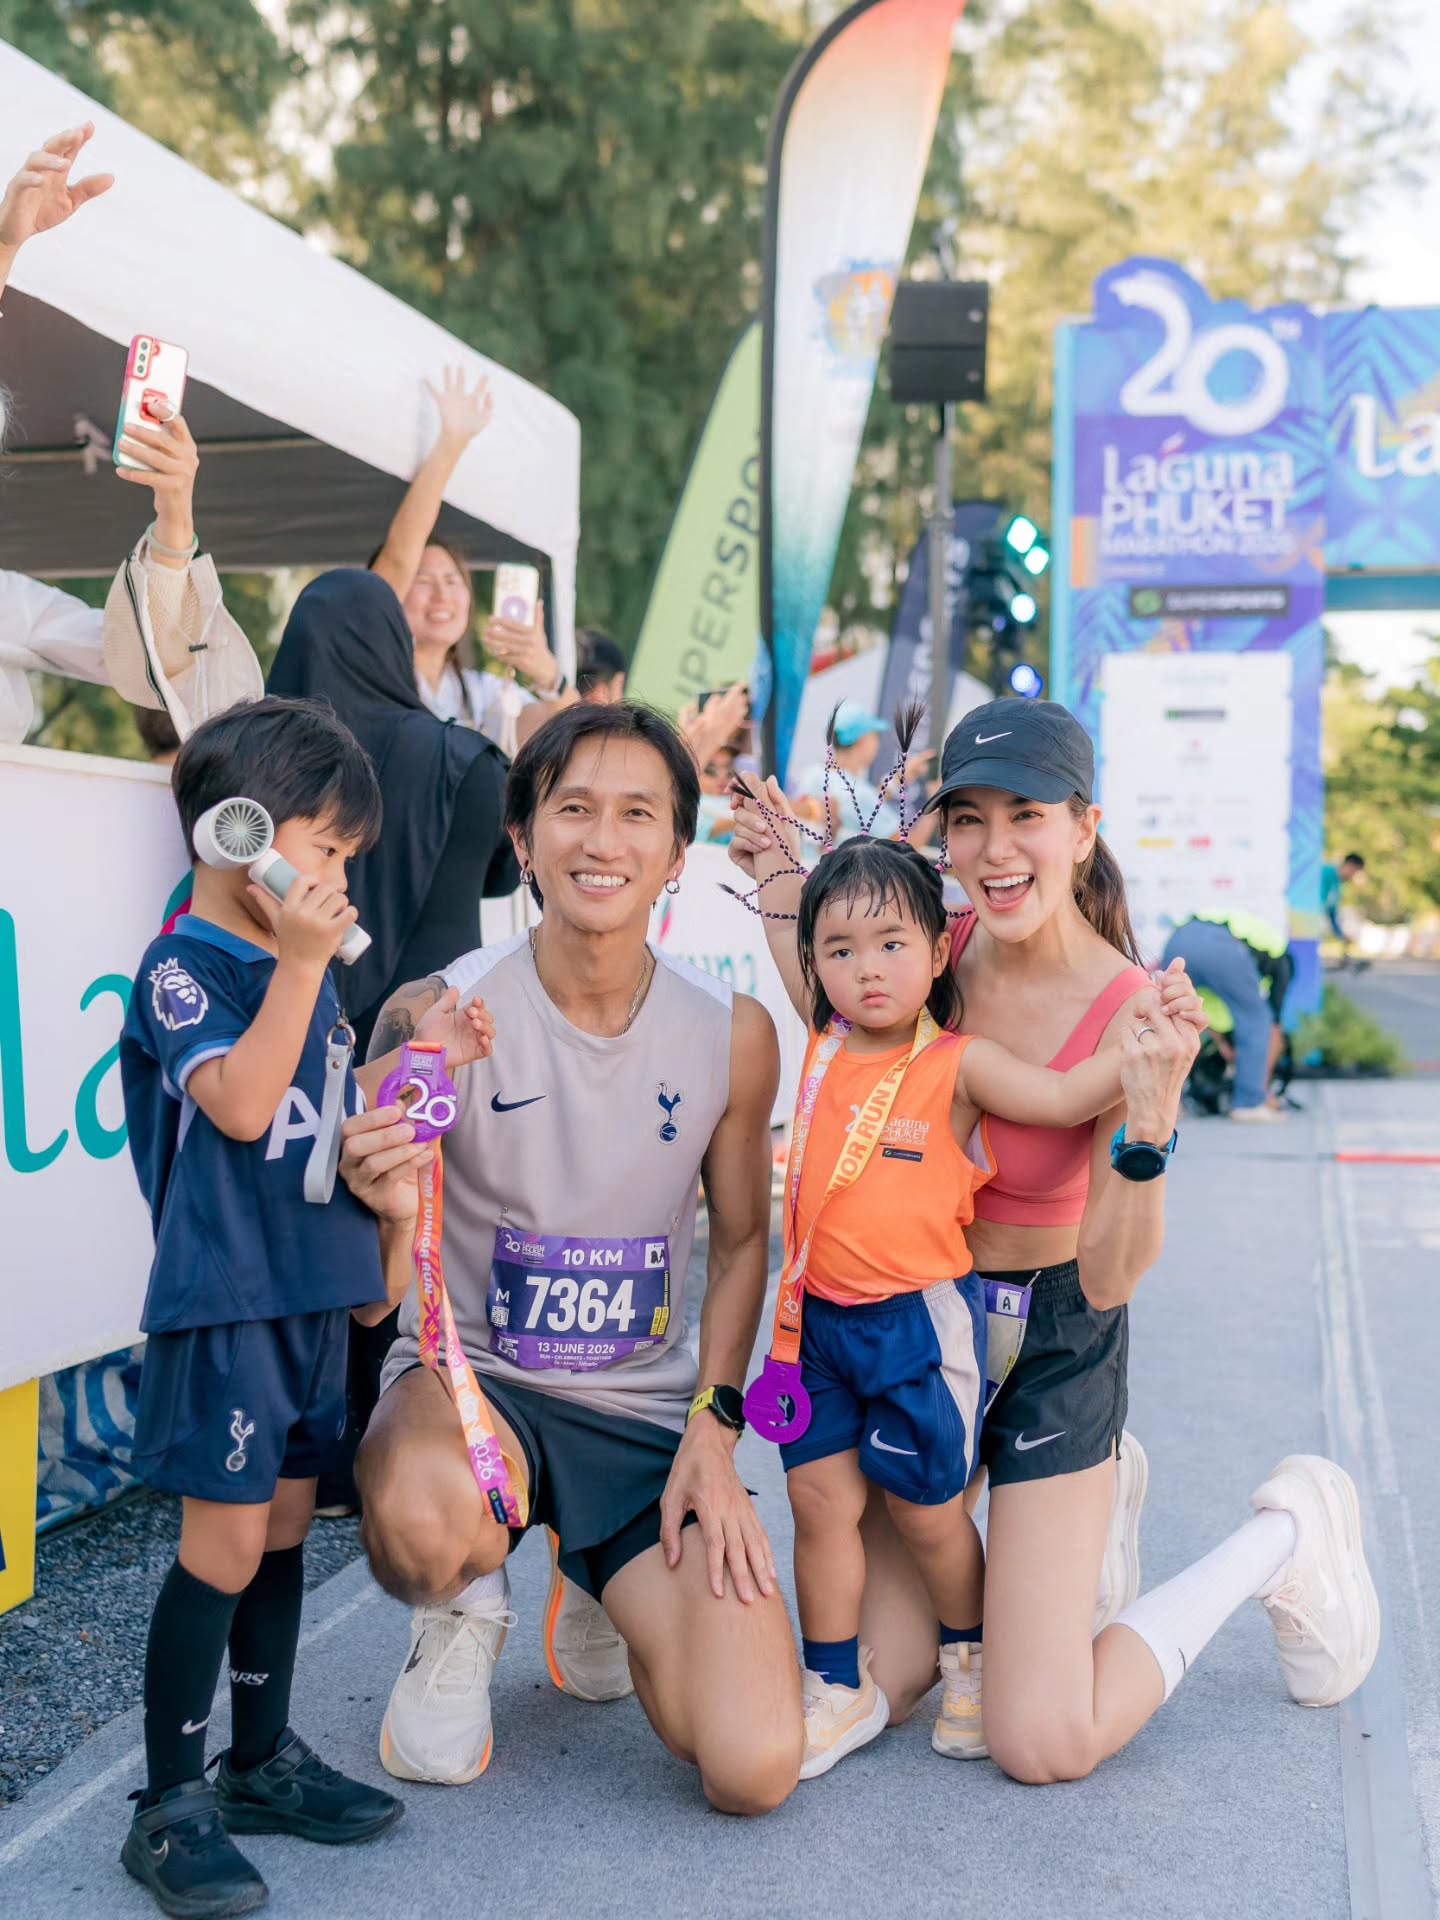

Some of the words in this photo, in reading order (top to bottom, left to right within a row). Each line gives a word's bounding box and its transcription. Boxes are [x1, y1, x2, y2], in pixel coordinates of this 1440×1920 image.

[1110, 271, 1290, 436] 20
[1102, 491, 1288, 534] PHUKET
[406, 1078, 456, 1128] 20
[856, 1088, 891, 1140] RUN
[423, 1174, 434, 1199] KM
[419, 1203, 433, 1259] JUNIOR
[562, 1249, 585, 1266] 10
[589, 1249, 623, 1266] KM
[422, 1262, 433, 1295] RUN
[496, 1287, 510, 1304] M
[524, 1275, 636, 1333] 7364
[1002, 1295, 1012, 1311] A
[537, 1341, 550, 1353] 13
[552, 1343, 585, 1354] JUNE
[587, 1343, 616, 1354] 2026
